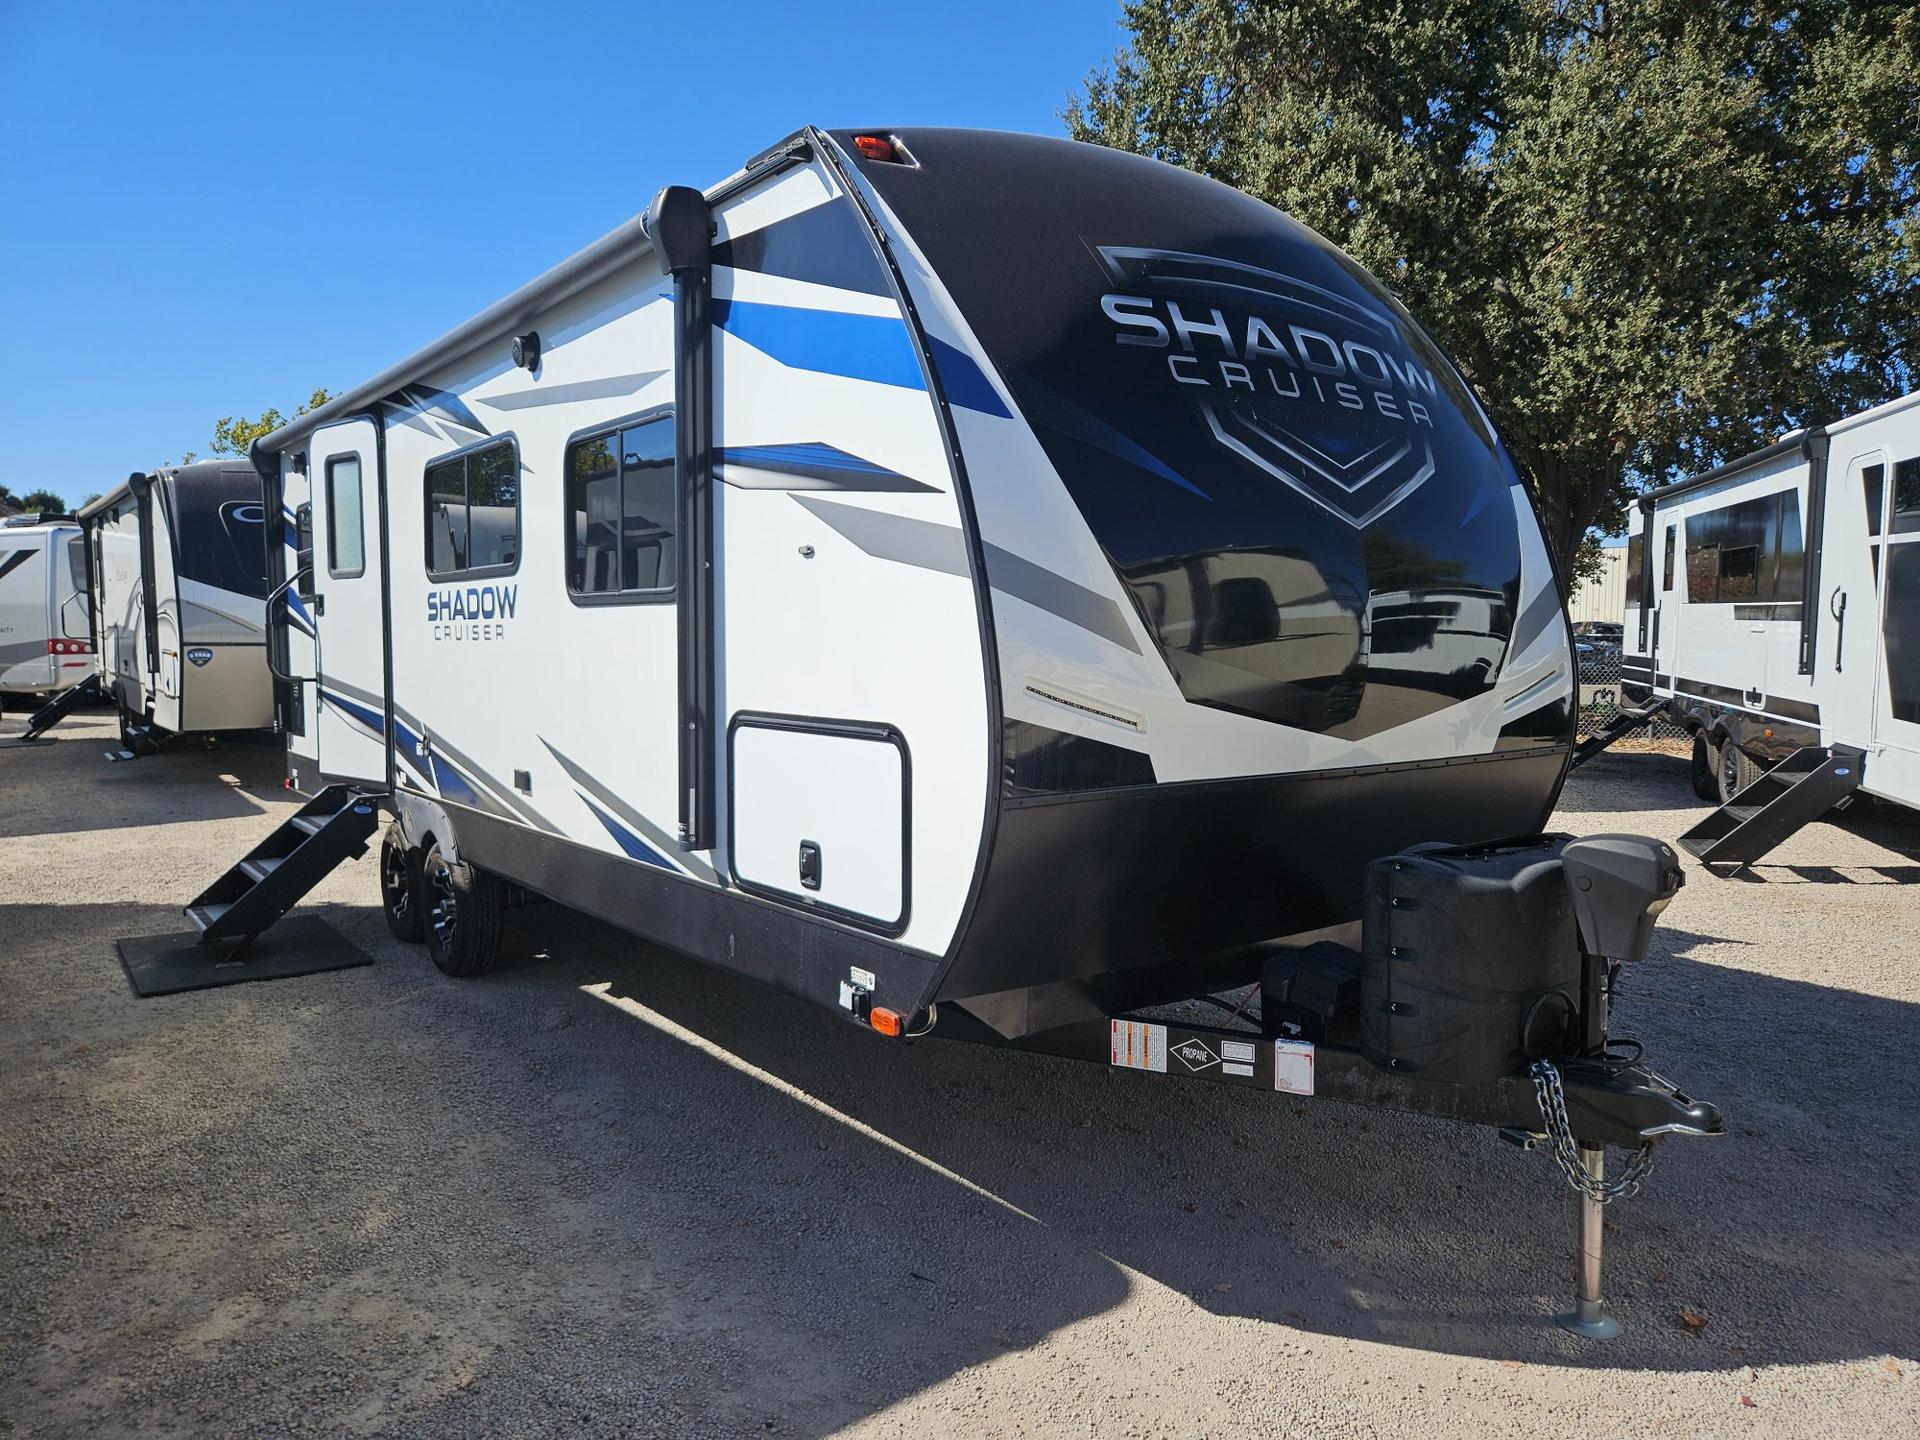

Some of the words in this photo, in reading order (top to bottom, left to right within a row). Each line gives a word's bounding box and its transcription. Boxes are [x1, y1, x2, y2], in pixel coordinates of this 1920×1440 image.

[1101, 294, 1438, 402] SHADOW
[1168, 354, 1434, 428] CRUISER
[427, 584, 517, 621] SHADOW
[434, 624, 504, 641] CRUISER
[1182, 1046, 1208, 1062] PROPANE
